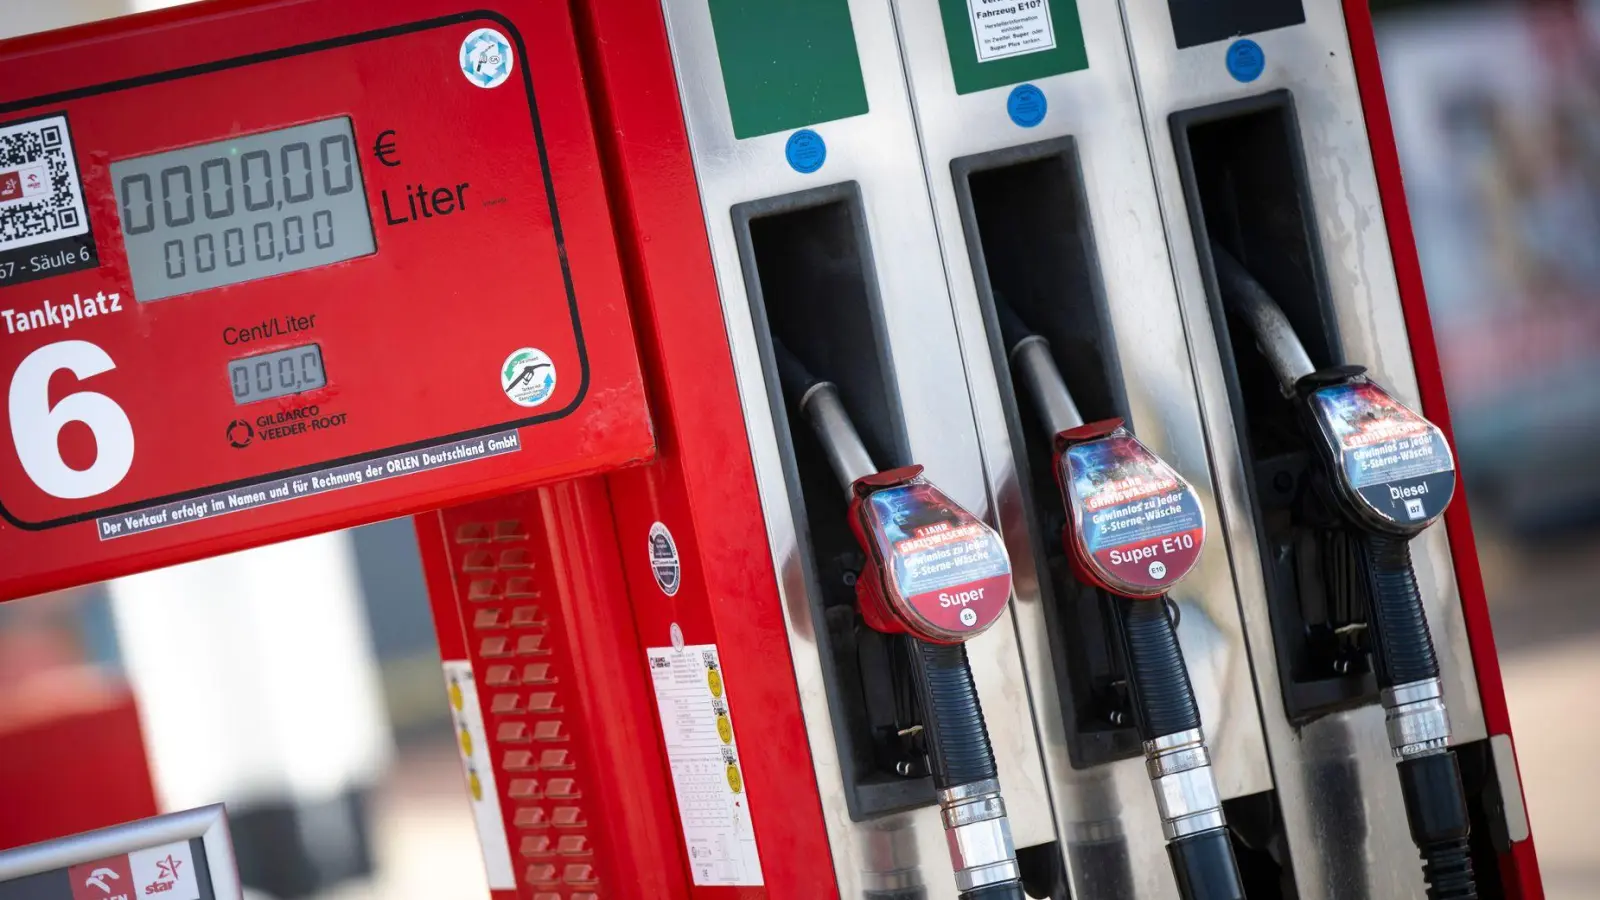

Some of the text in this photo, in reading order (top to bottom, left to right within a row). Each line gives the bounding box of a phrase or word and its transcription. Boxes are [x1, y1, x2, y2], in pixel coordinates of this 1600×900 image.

[976, 0, 1041, 19] Fahrzeug E10?
[1013, 31, 1029, 39] Super
[373, 129, 401, 167] €
[382, 182, 470, 226] Liter
[30, 250, 76, 272] Säule
[79, 246, 90, 261] 6
[1, 291, 122, 334] Tankplatz
[223, 314, 316, 346] Cent/Liter
[8, 339, 135, 499] 6
[256, 405, 319, 428] GILBARCO
[258, 413, 348, 442] VEEDER-ROOT
[1399, 439, 1410, 449] zu
[102, 435, 518, 536] Der Verkauf erfolgt im Namen und für Rechnung der ORLEN Deutschland GmbH
[1390, 481, 1429, 500] Diesel
[1092, 501, 1144, 524] Gewinnlos
[1144, 498, 1157, 510] zu
[1100, 505, 1182, 534] 5-Sterne-Wäsche
[1410, 505, 1421, 513] B7
[953, 546, 965, 557] zu
[1109, 534, 1194, 565] Super E10
[1151, 566, 1164, 574] E10
[938, 587, 985, 608] Super
[145, 879, 174, 895] star
